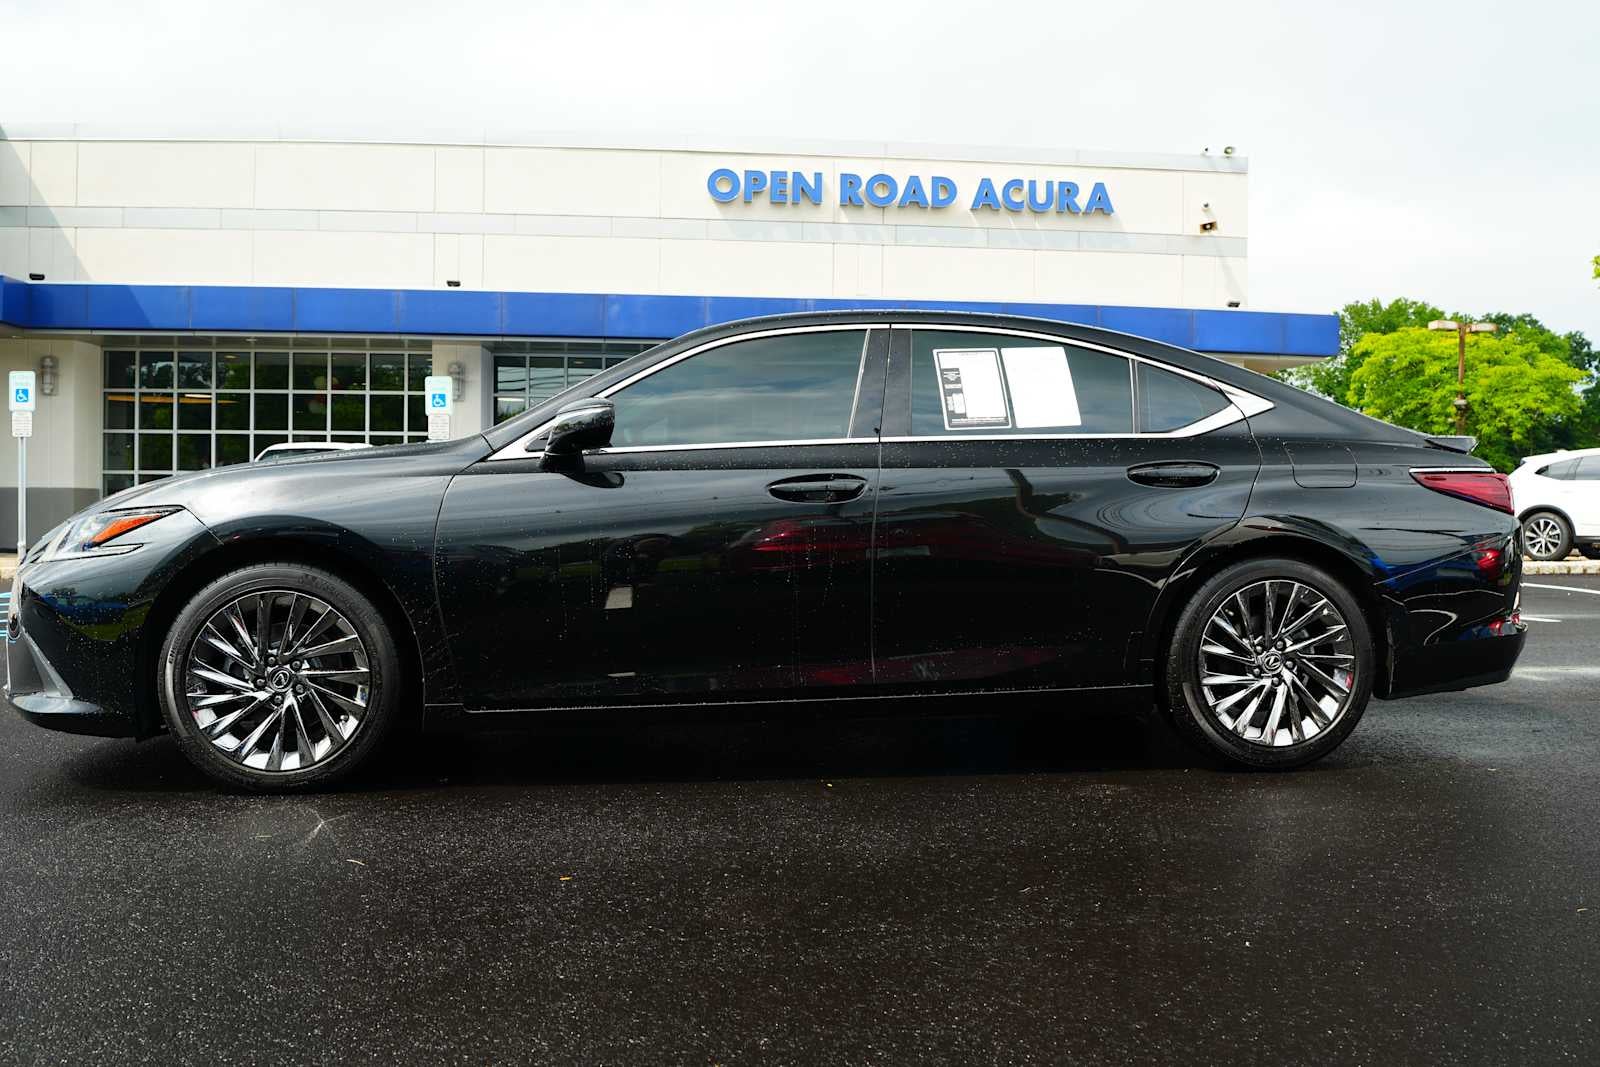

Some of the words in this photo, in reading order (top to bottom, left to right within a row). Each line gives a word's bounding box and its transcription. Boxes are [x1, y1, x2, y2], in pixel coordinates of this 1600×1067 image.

[707, 168, 823, 205] OPEN
[839, 173, 957, 208] ROAD
[971, 177, 1113, 215] ACURA
